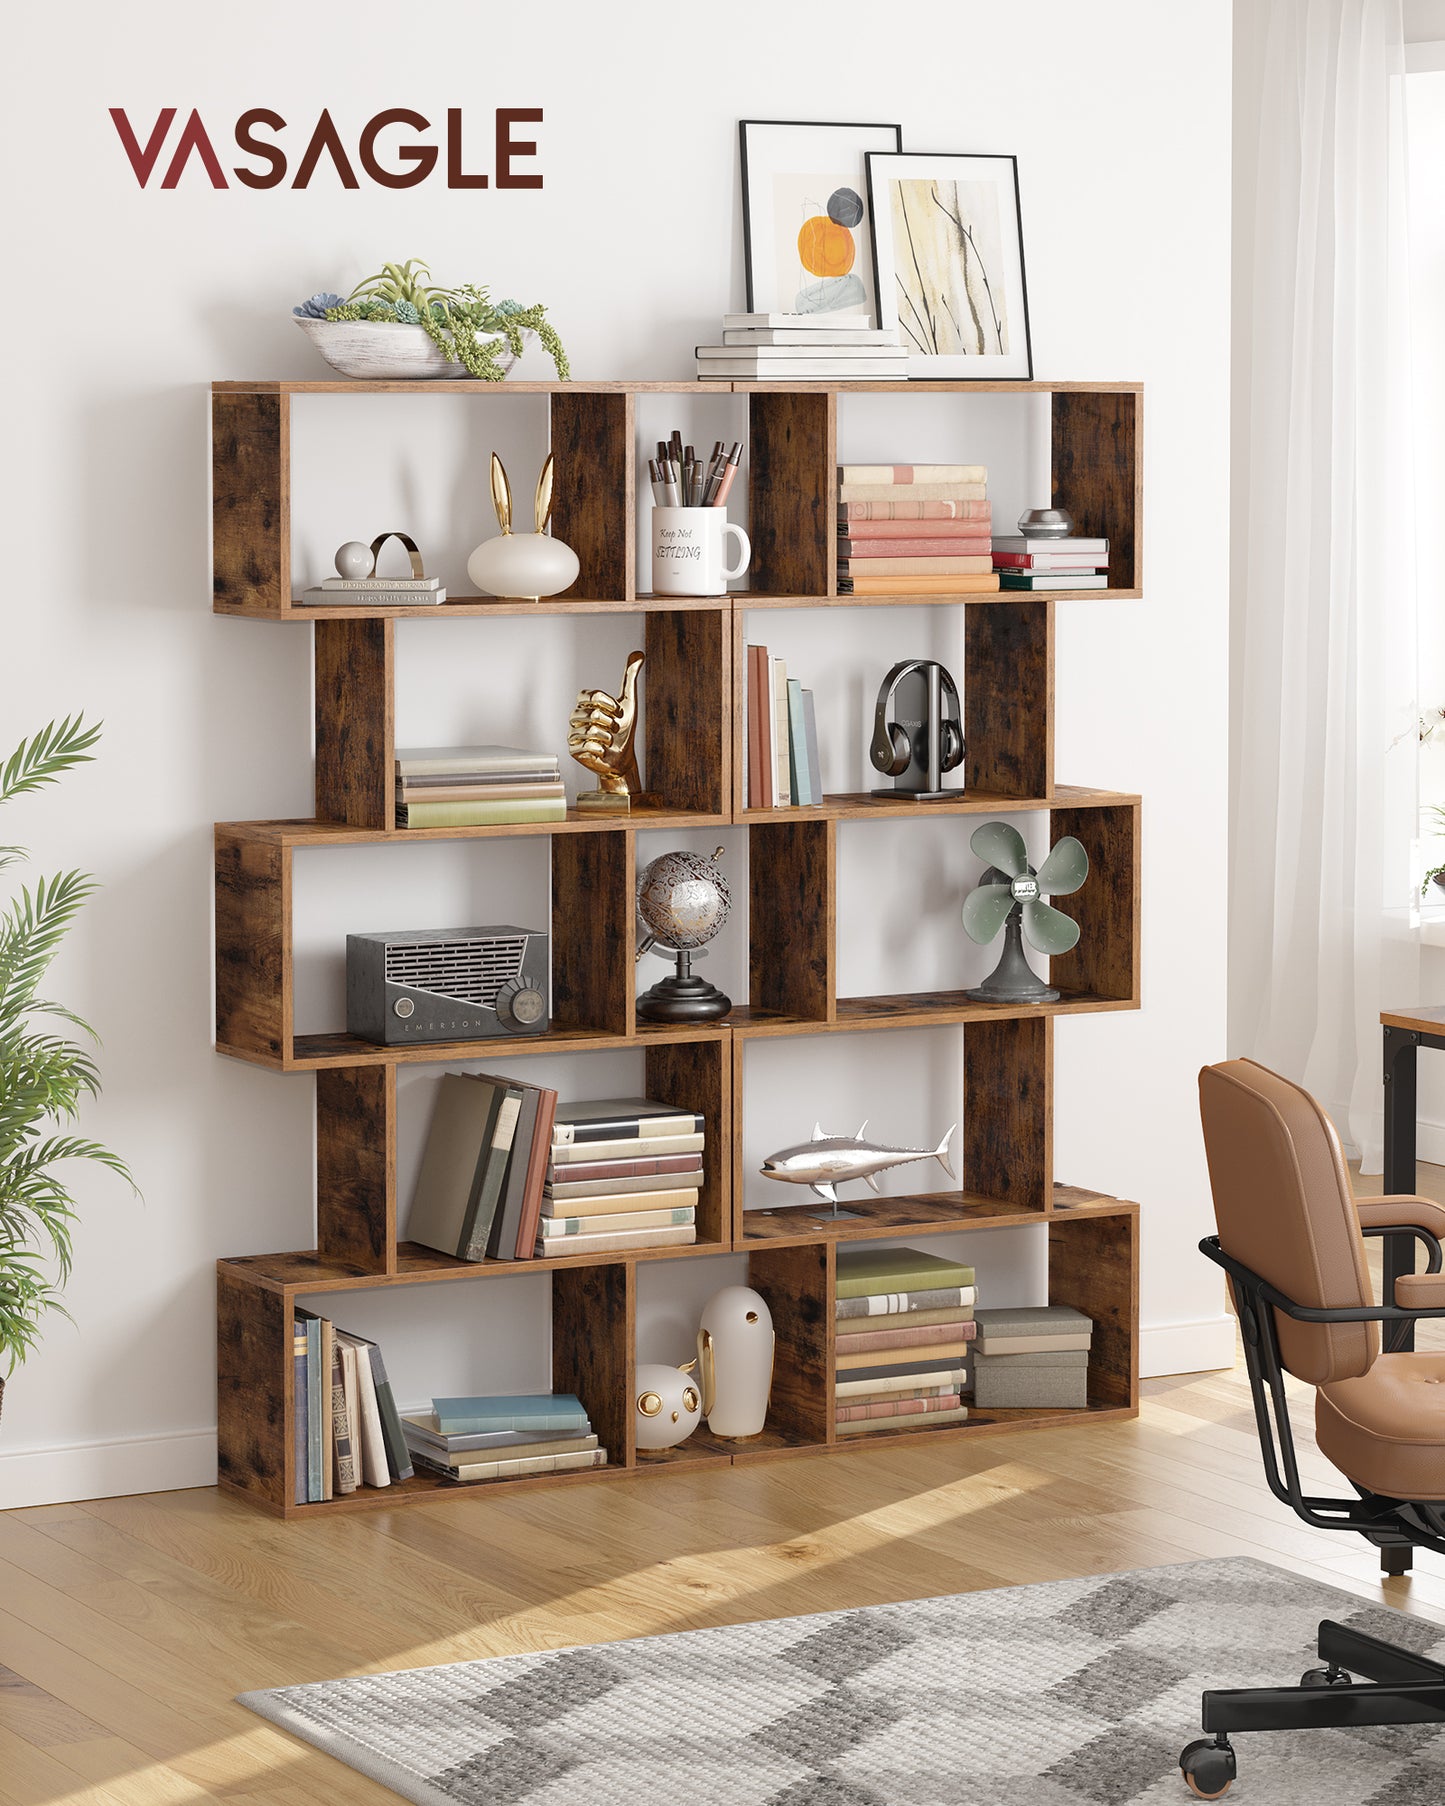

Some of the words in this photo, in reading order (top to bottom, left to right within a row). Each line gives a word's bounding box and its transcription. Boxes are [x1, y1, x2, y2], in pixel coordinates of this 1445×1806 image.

[660, 528, 676, 542] Keep
[656, 545, 701, 560] SETTLING
[404, 1020, 480, 1031] EMERSON
